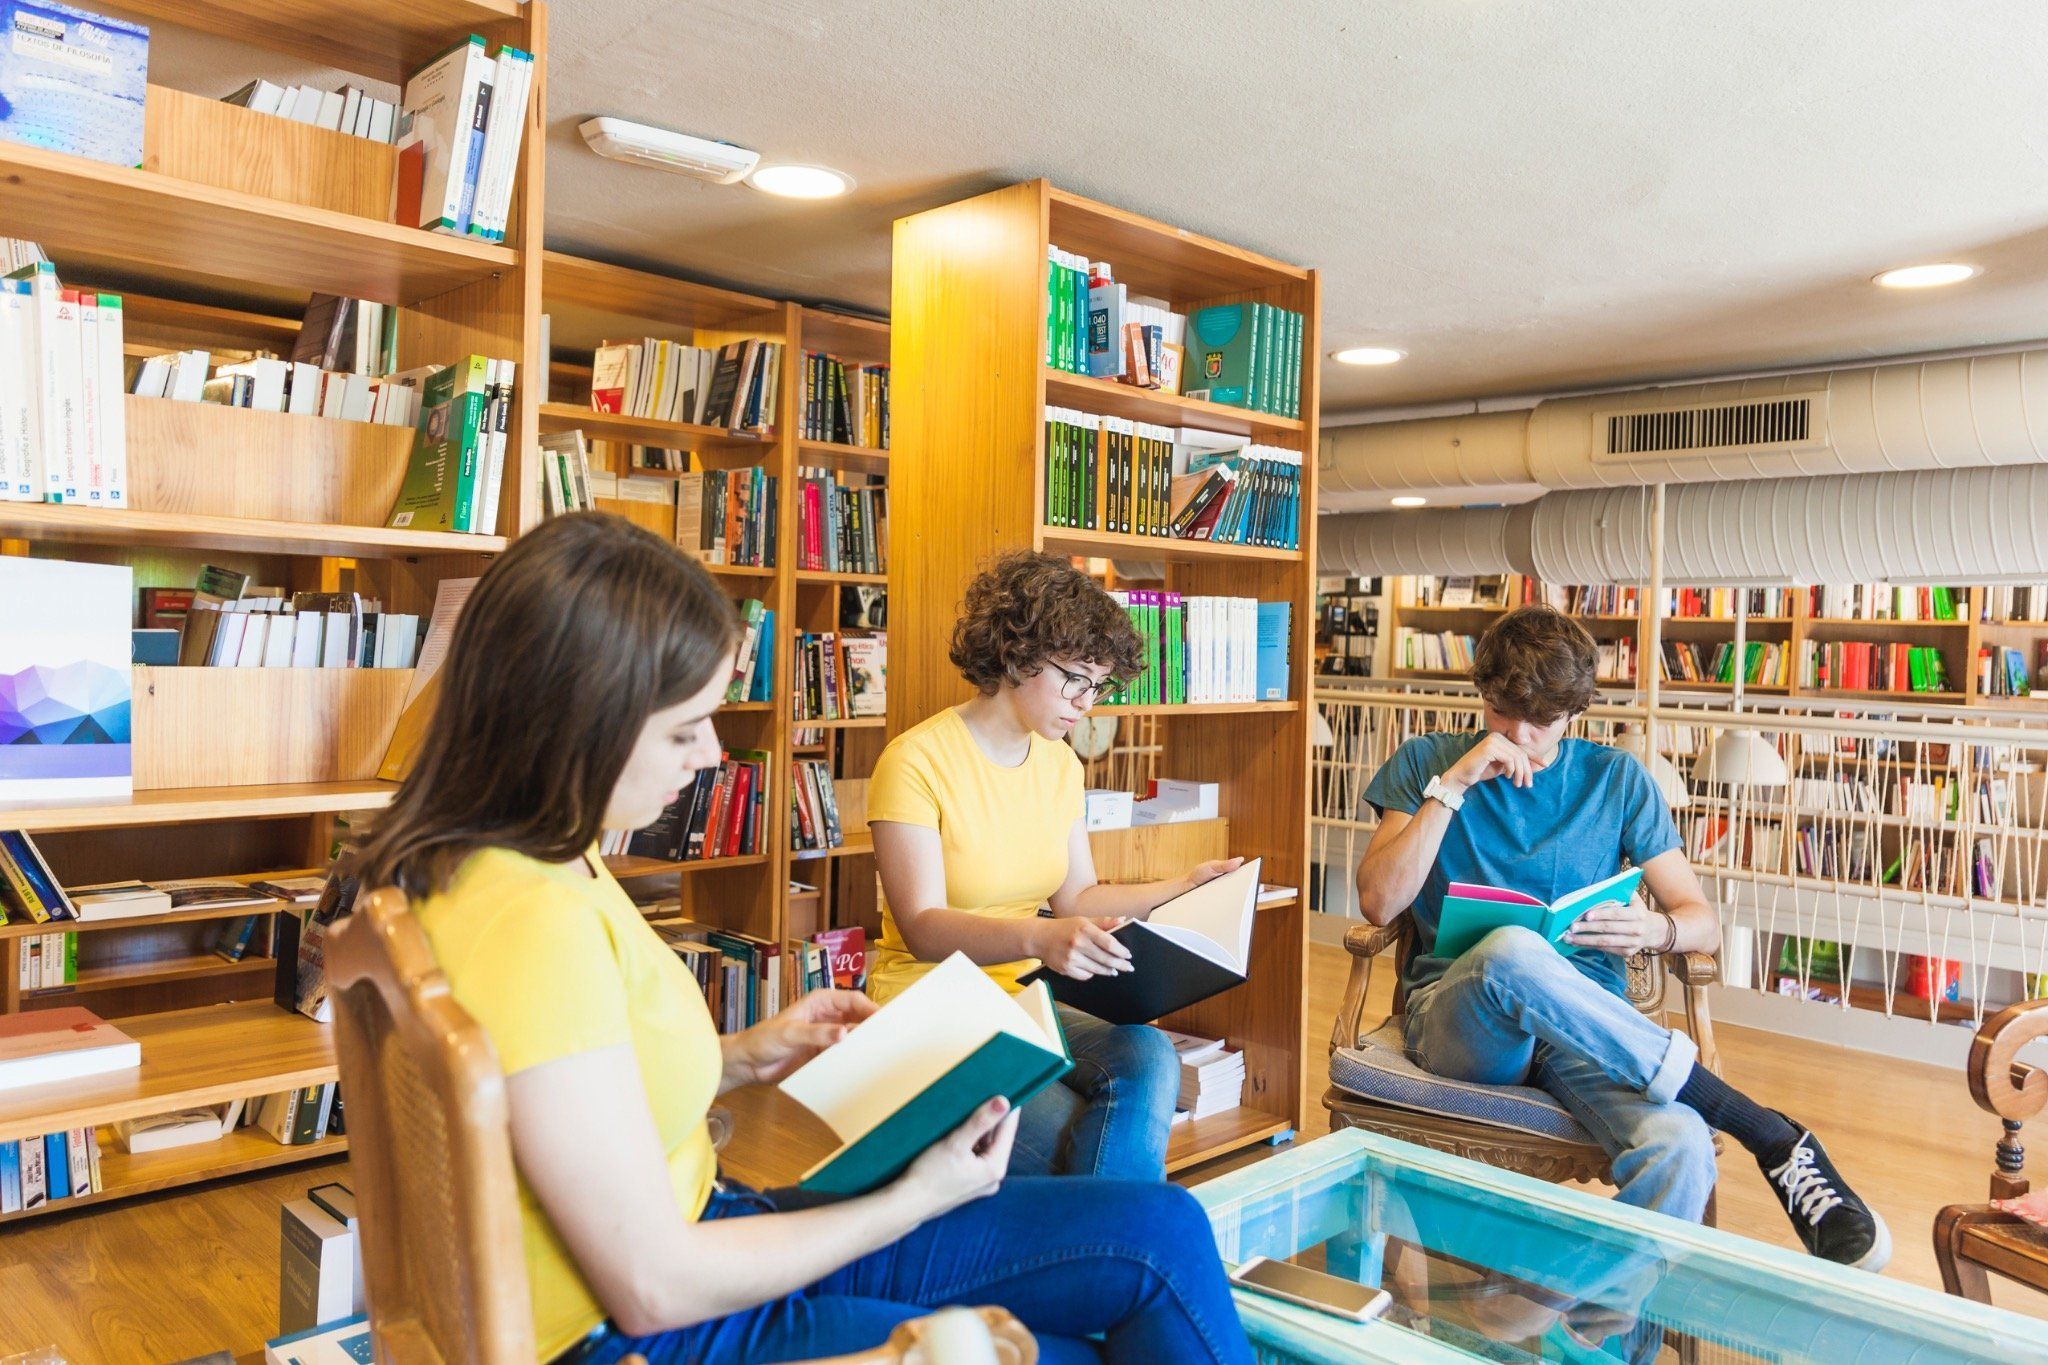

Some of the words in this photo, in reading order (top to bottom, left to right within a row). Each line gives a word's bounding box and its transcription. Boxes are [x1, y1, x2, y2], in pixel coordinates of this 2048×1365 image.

[16, 33, 50, 48] TEXTOS
[52, 43, 63, 52] DE
[836, 952, 863, 972] PC
